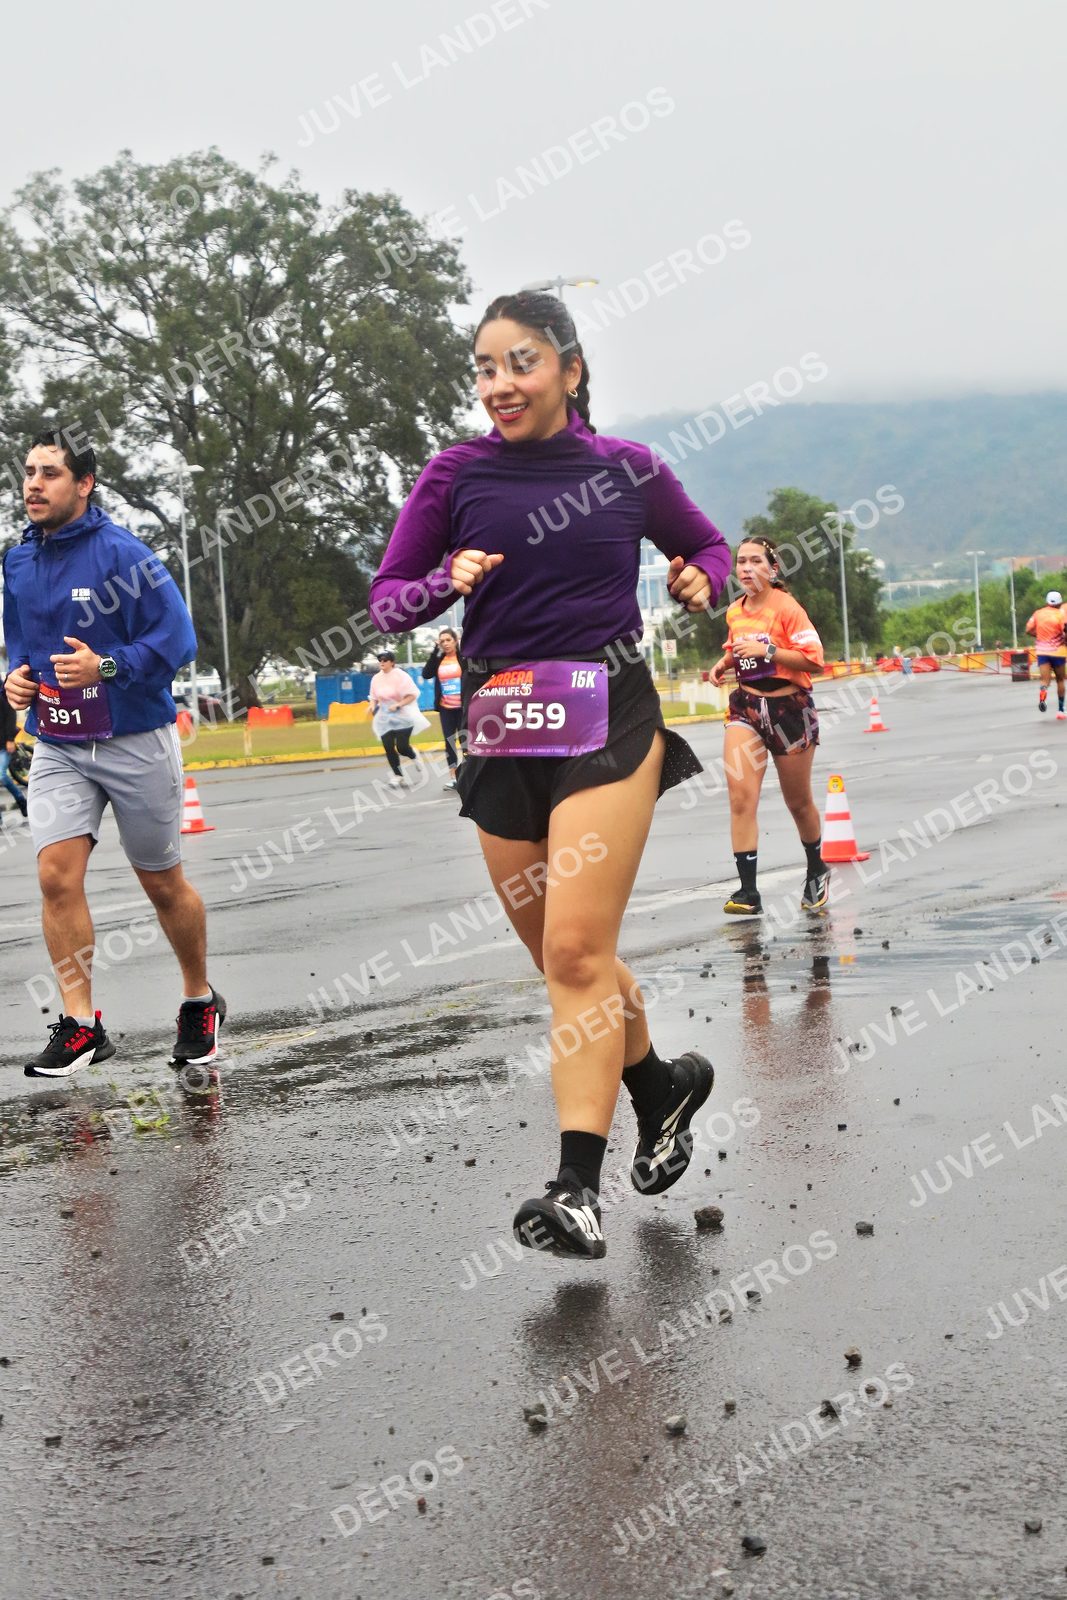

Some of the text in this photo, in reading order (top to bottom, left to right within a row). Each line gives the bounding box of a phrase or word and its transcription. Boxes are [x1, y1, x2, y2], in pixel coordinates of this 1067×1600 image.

[740, 658, 757, 670] 505
[487, 671, 533, 688] ARRERA
[571, 670, 597, 688] 15K
[82, 686, 98, 699] 15K
[48, 707, 81, 725] 391
[505, 703, 566, 730] 559
